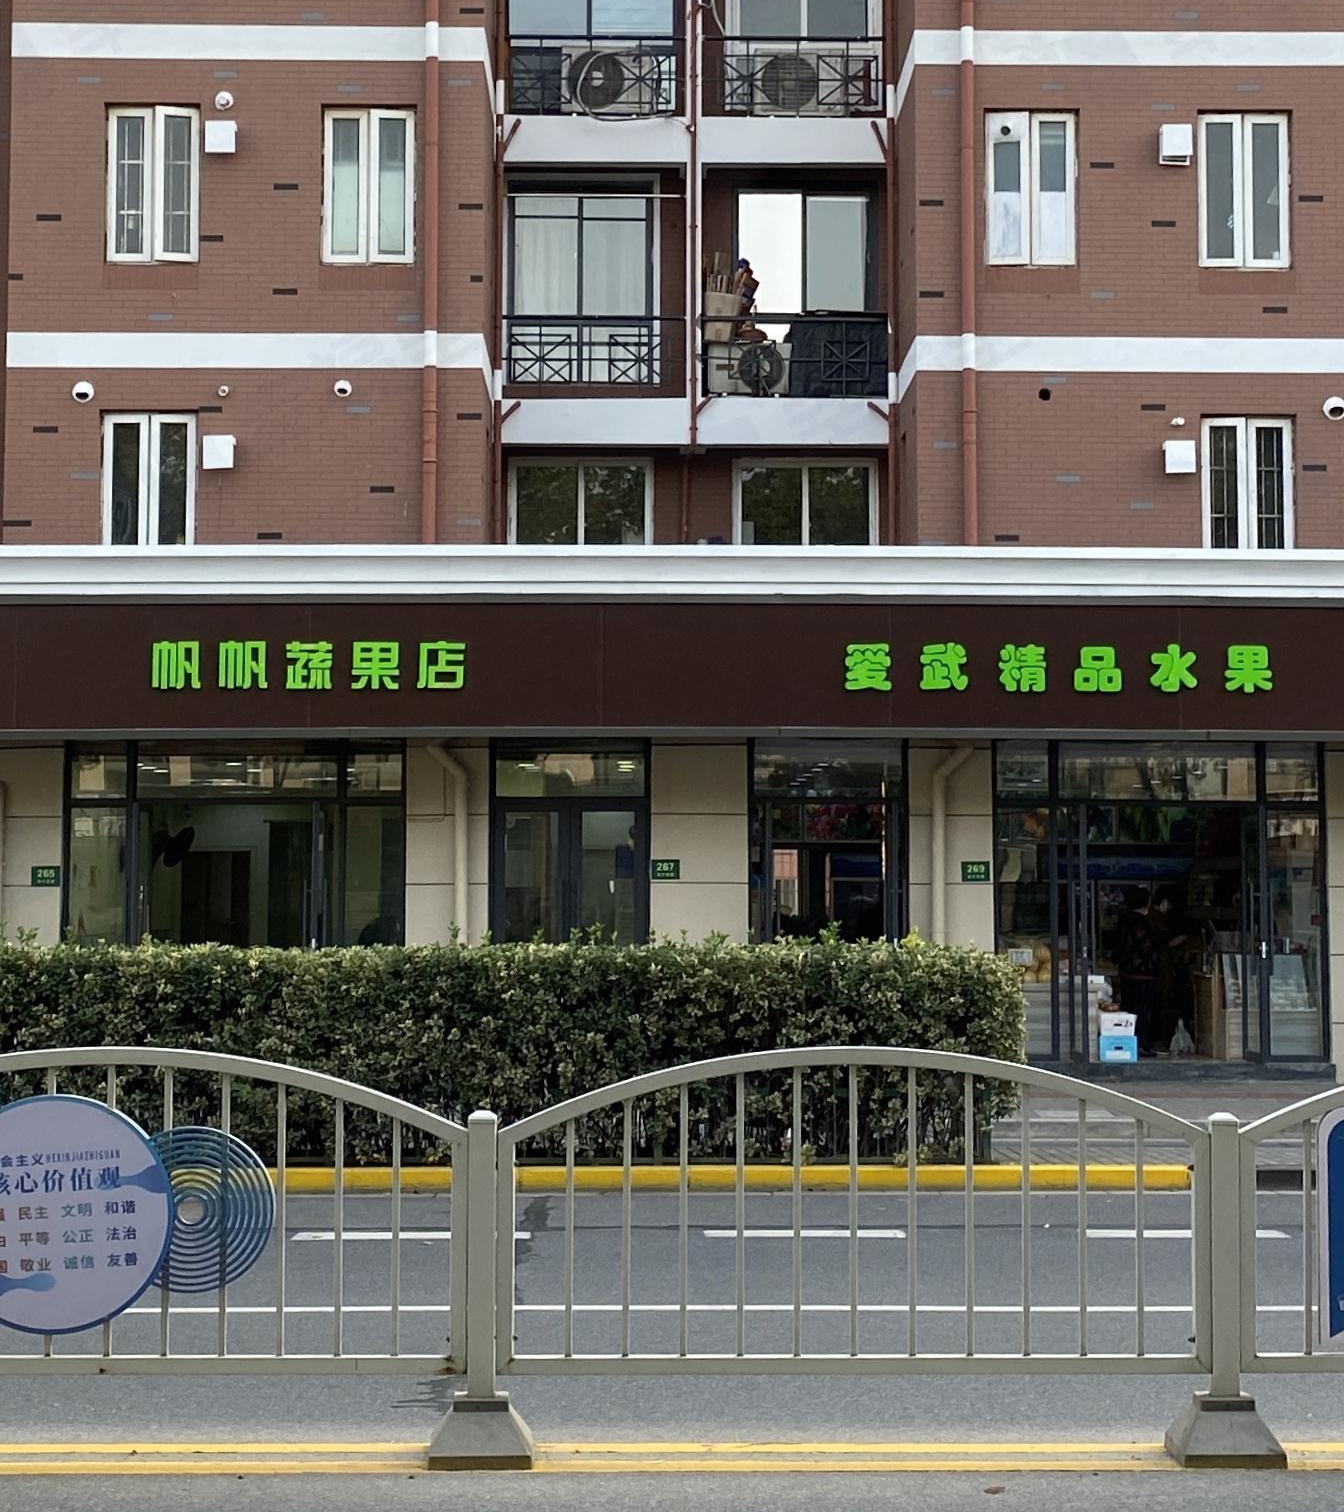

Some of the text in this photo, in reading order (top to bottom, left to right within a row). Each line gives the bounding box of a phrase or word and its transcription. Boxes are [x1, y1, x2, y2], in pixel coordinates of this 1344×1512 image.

[151, 639, 467, 690] 帆帆蔬果店
[844, 642, 1273, 693] 爱武精品水果
[36, 869, 55, 878] 265
[656, 862, 674, 871] 267
[18, 1206, 49, 1220] 民主
[61, 1203, 92, 1218] 文明
[105, 1200, 136, 1215] 和谐
[19, 1232, 50, 1247] 平等
[63, 1229, 94, 1243] 公正
[106, 1226, 136, 1241] 法治
[20, 1258, 52, 1272] 敬业
[64, 1256, 94, 1270] 诚信
[107, 1252, 138, 1267] 友善
